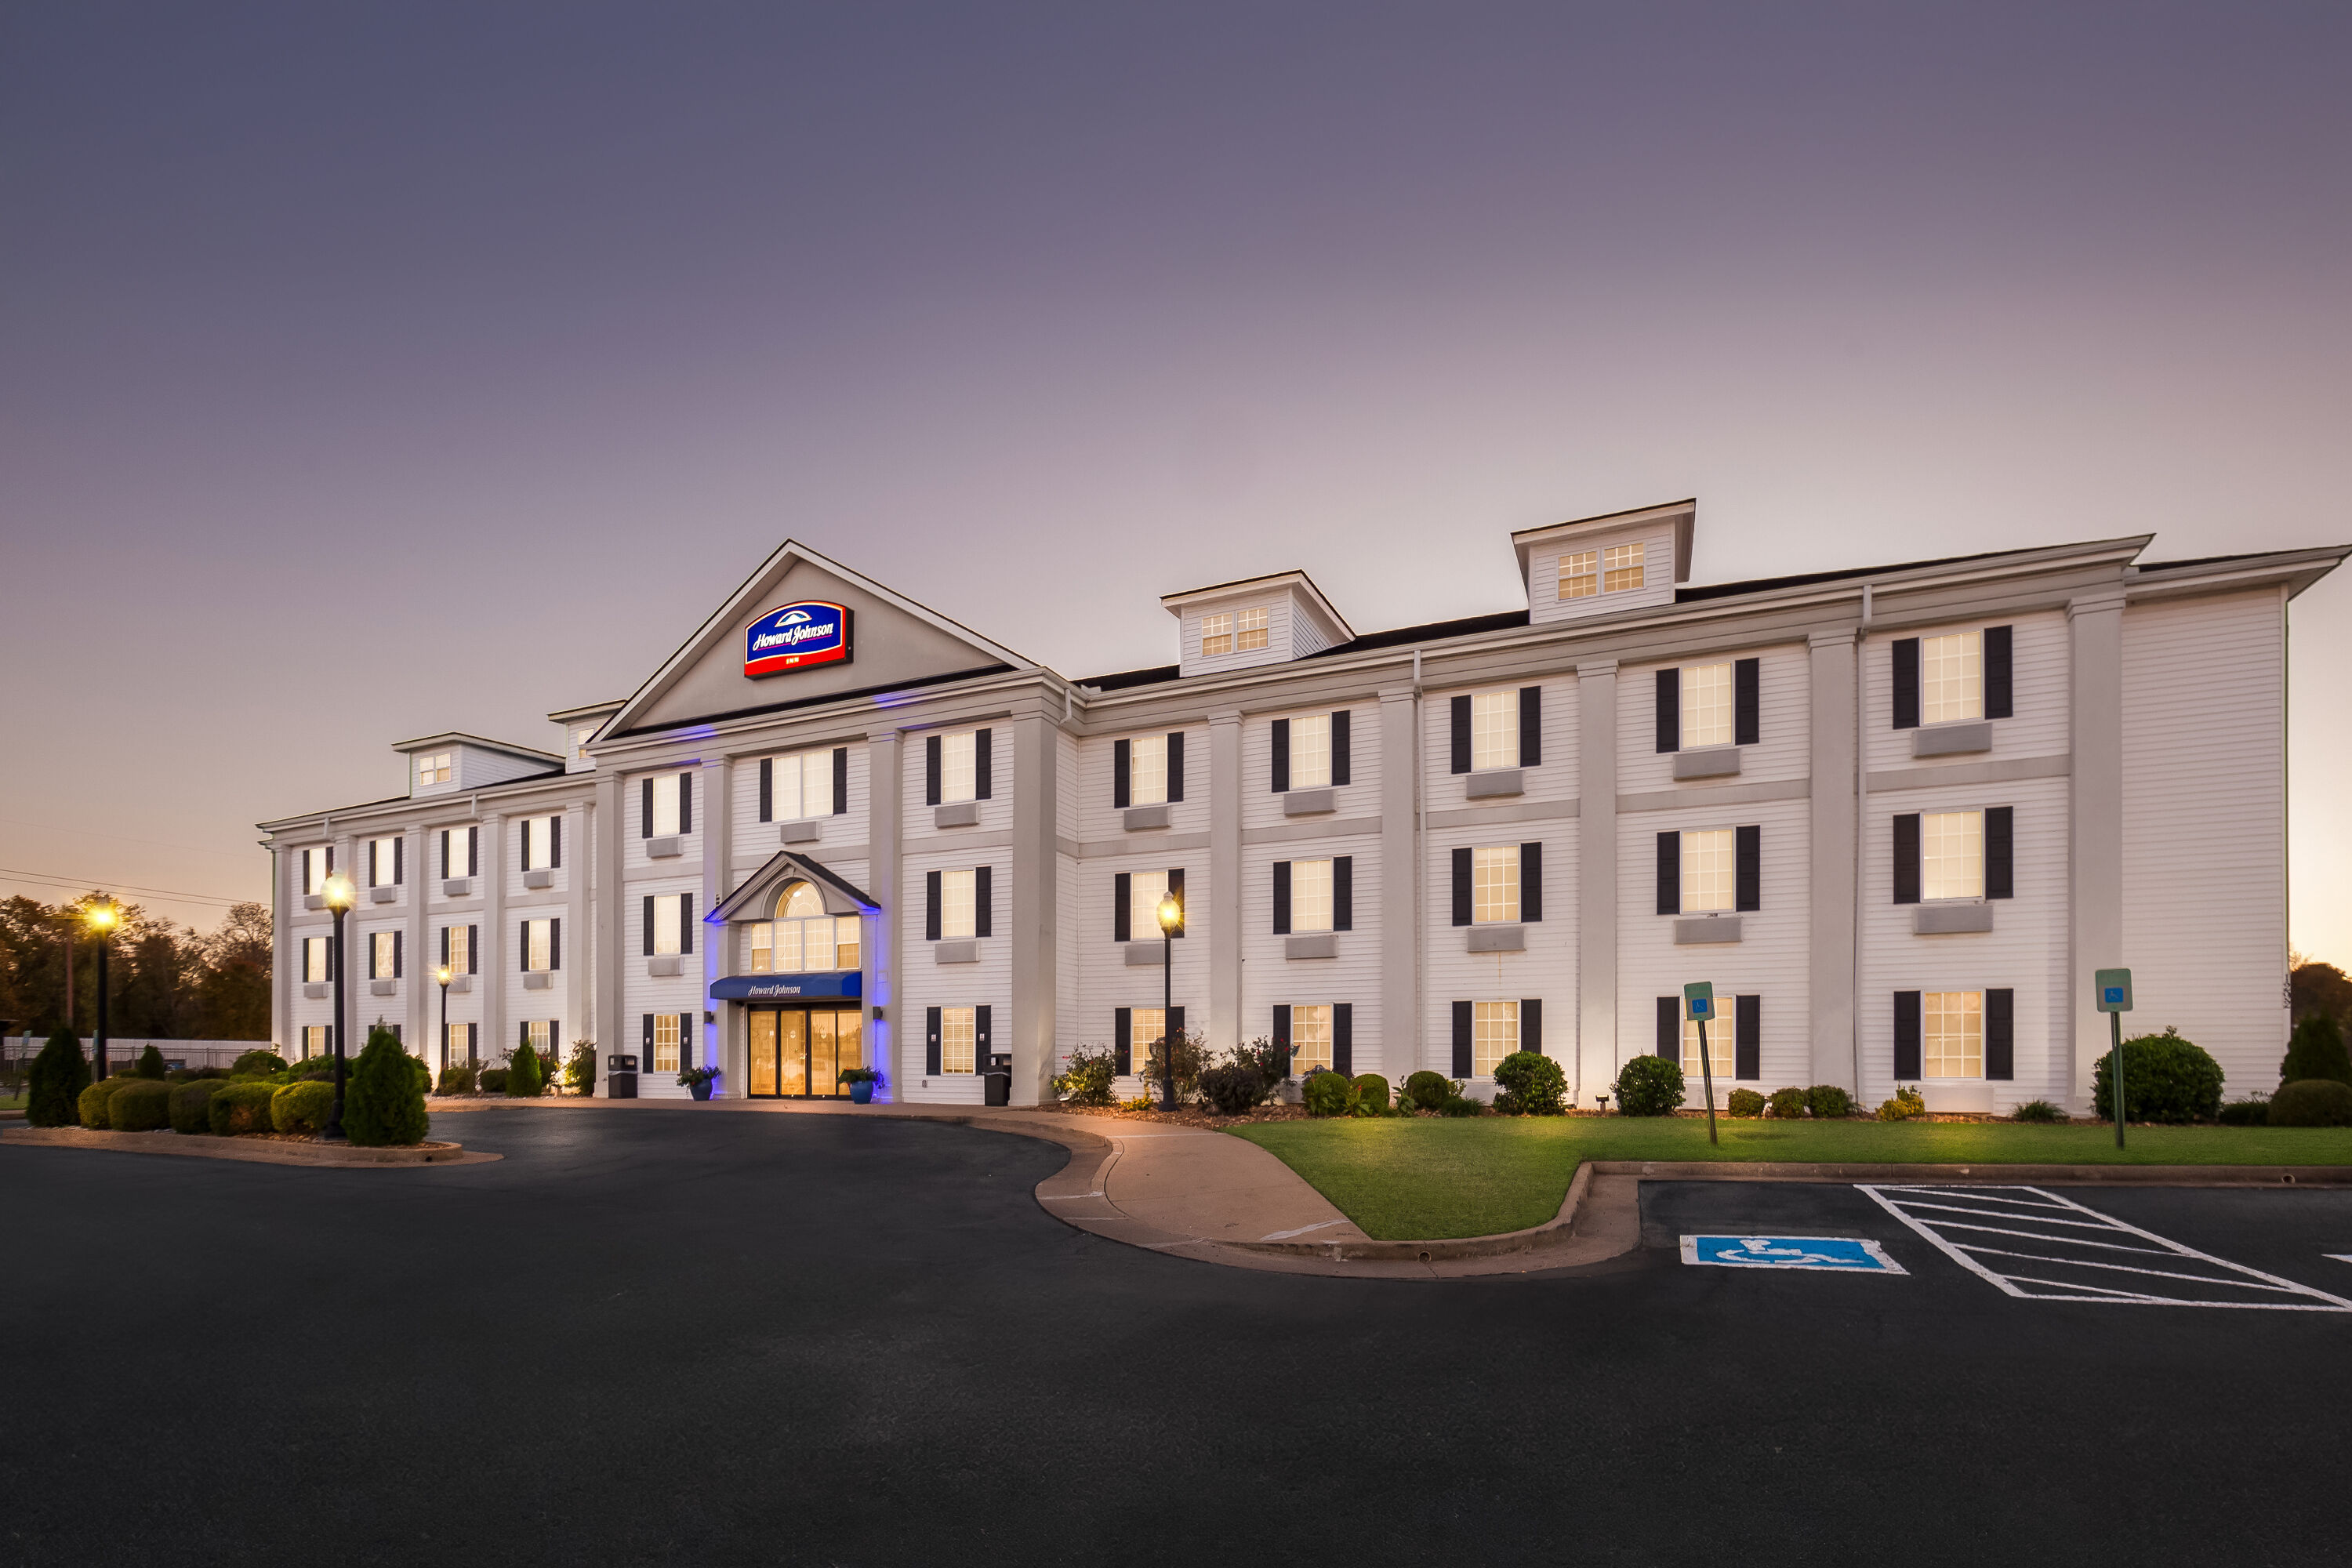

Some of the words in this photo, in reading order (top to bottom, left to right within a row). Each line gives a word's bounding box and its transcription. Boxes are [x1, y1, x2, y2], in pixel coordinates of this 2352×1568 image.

[753, 628, 793, 651] Howard
[791, 622, 833, 646] Johnson
[786, 656, 800, 665] INN
[748, 985, 774, 996] Howard
[774, 984, 800, 997] Johnson
